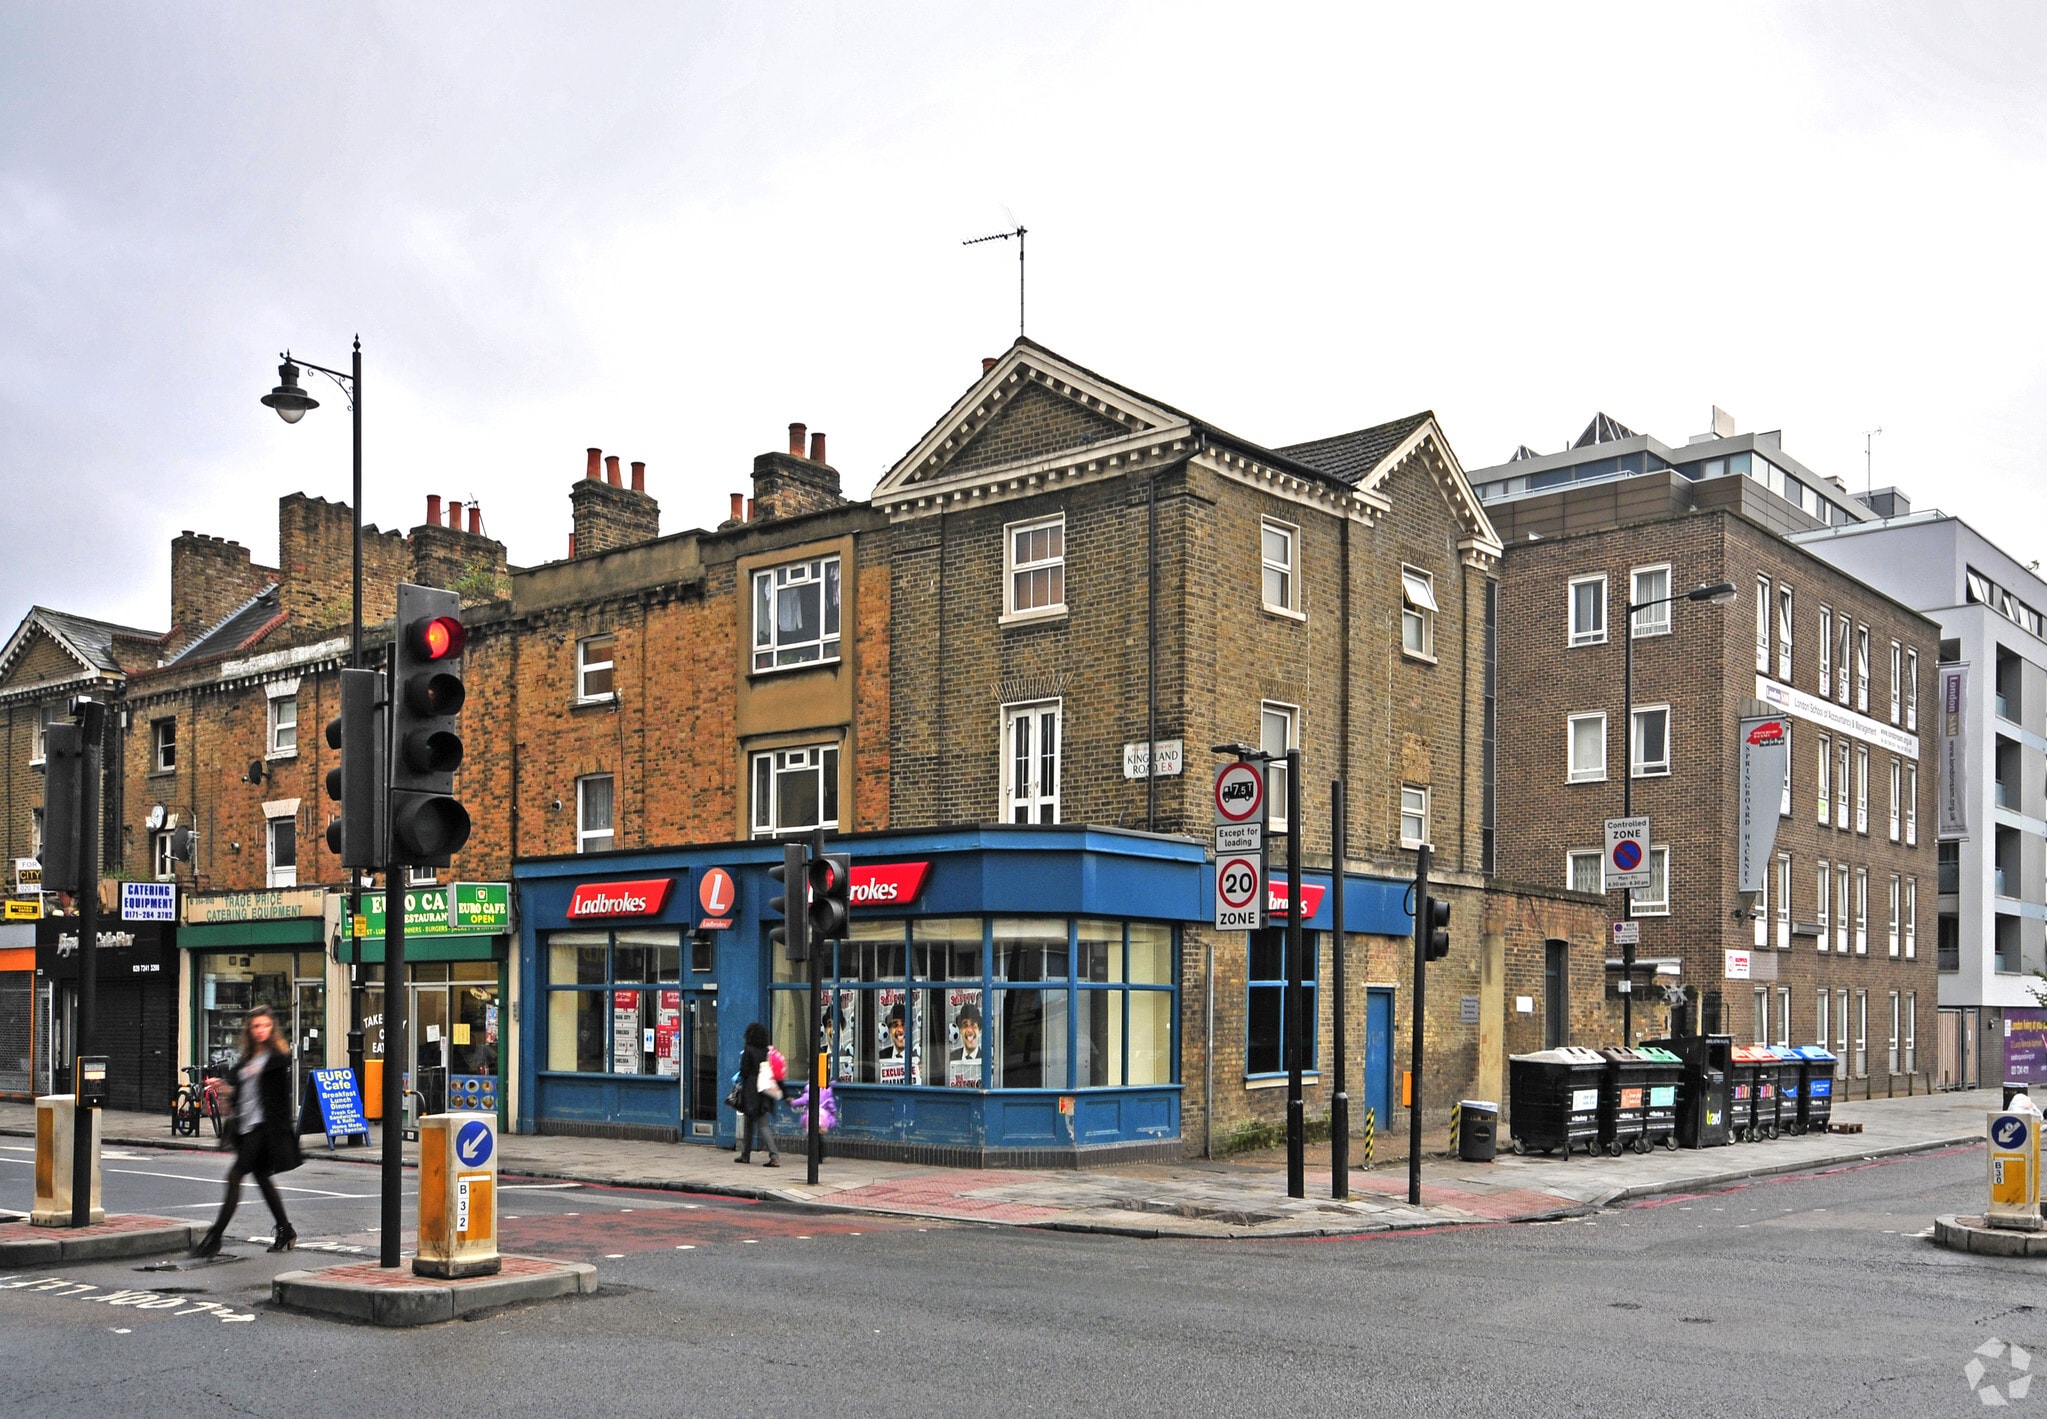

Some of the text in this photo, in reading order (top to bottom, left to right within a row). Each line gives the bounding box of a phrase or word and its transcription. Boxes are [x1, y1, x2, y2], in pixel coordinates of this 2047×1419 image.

[1794, 697, 1810, 711] London
[1810, 702, 1824, 717] School
[1824, 709, 1829, 718] of
[1948, 676, 1959, 735] London SAM
[1127, 750, 1179, 765] KINGLAND
[1948, 740, 1956, 822] www.londonsam.org.uk
[1607, 820, 1647, 829] Controlled
[1219, 827, 1258, 839] Except for
[1613, 829, 1641, 839] ZONE
[1224, 838, 1253, 848] loading
[20, 870, 40, 880] CITY
[1225, 872, 1253, 894] 20
[128, 884, 170, 896] CATERING
[708, 873, 726, 910] L
[124, 897, 173, 909] EQUIPMENT
[224, 895, 251, 908] TRADE
[255, 893, 282, 906] PRICE
[421, 891, 449, 911] CA
[574, 892, 646, 915] Ladbrokes
[206, 904, 303, 922] CATERING EQUIPMENT
[458, 902, 506, 914] EURO CAFE
[404, 912, 449, 925] ESTAURAN
[470, 914, 495, 924] OPEN
[702, 919, 728, 928] Ladbrokes
[1220, 913, 1255, 925] ZONE
[425, 925, 448, 933] BURGERS
[363, 1013, 383, 1029] TAKE
[316, 1070, 352, 1082] EURO
[881, 1066, 916, 1078] EXCLUSE
[323, 1080, 351, 1091] Cafe
[322, 1090, 356, 1099] Breakfast
[329, 1113, 360, 1121] Sandwiches
[1994, 1161, 2003, 1184] B30
[459, 1184, 467, 1227] B32
[81, 1289, 223, 1316] LOOK
